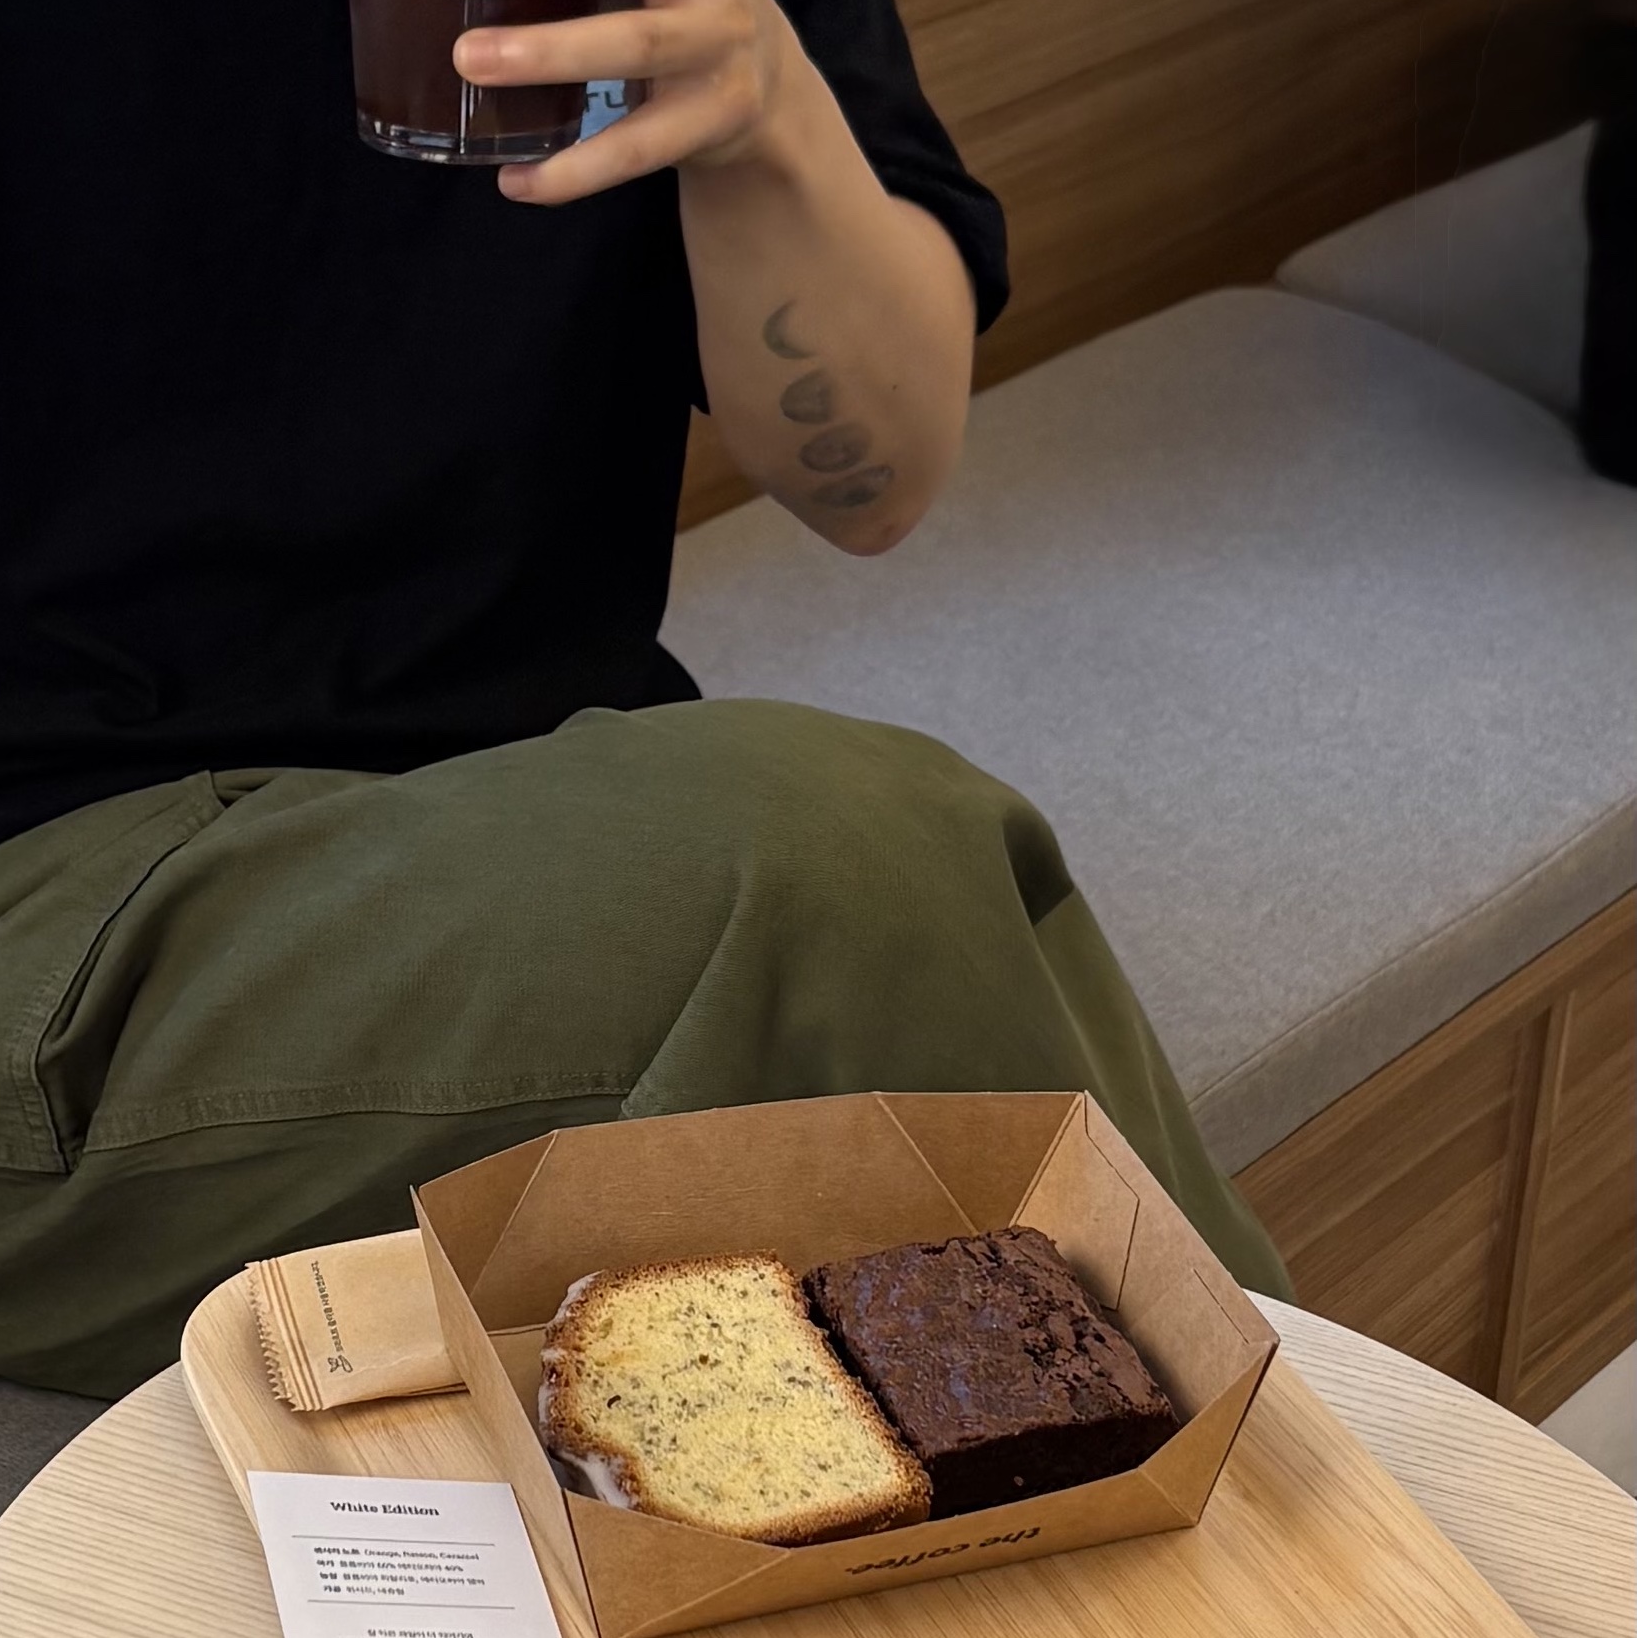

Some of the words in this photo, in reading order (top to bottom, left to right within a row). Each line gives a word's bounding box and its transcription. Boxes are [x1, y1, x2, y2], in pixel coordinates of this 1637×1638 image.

[329, 1501, 379, 1514] White
[381, 1503, 440, 1517] Edition
[978, 1526, 1041, 1548] the
